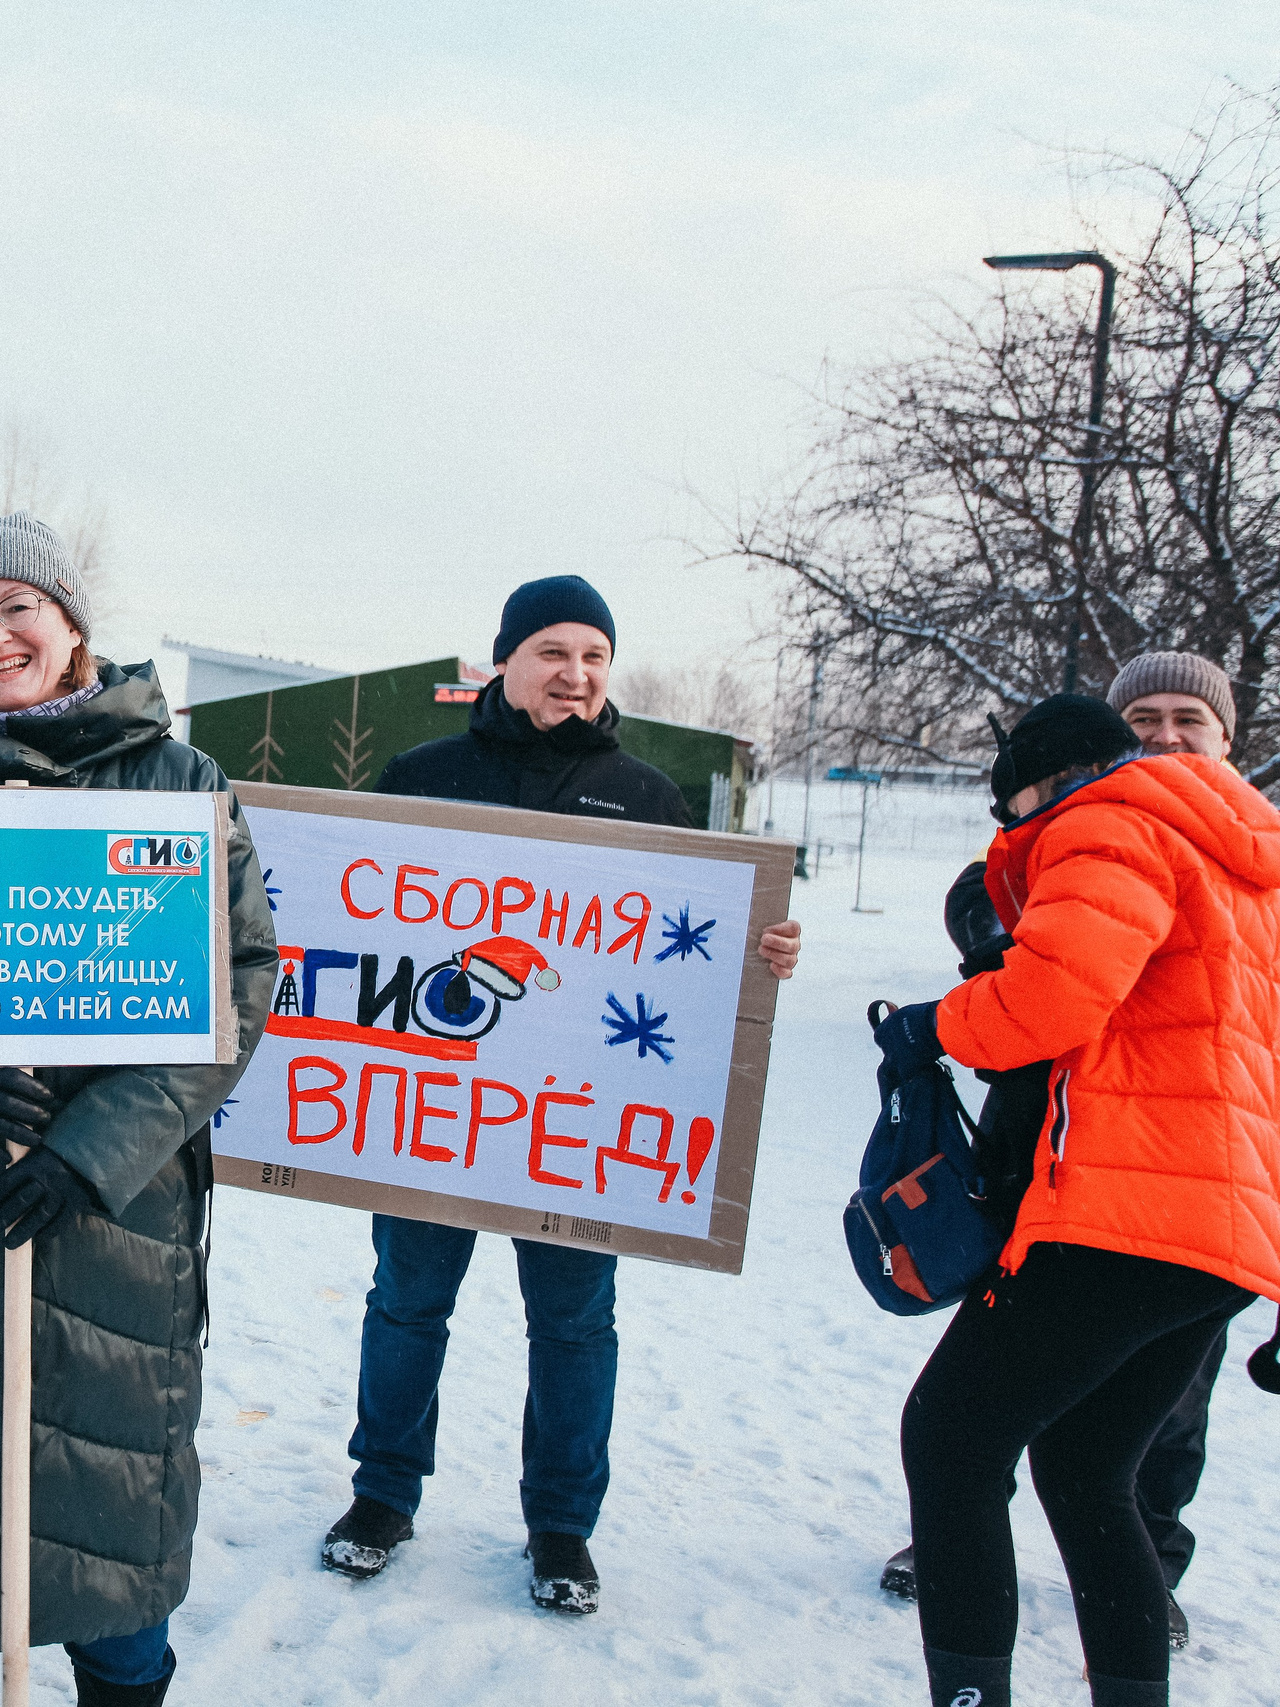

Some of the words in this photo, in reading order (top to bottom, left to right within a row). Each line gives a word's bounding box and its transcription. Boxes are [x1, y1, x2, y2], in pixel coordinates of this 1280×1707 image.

[588, 797, 625, 811] Columbia
[8, 886, 166, 914] ПОХУДЕТЬ,
[341, 857, 652, 964] СБОРНАЯ
[97, 923, 130, 947] НЕ
[78, 959, 186, 987] ПИЦЦУ,
[10, 996, 48, 1020] ЗА
[59, 991, 112, 1020] НЕЙ
[122, 996, 191, 1020] САМ
[287, 1055, 715, 1205] ВПЕРЁД!
